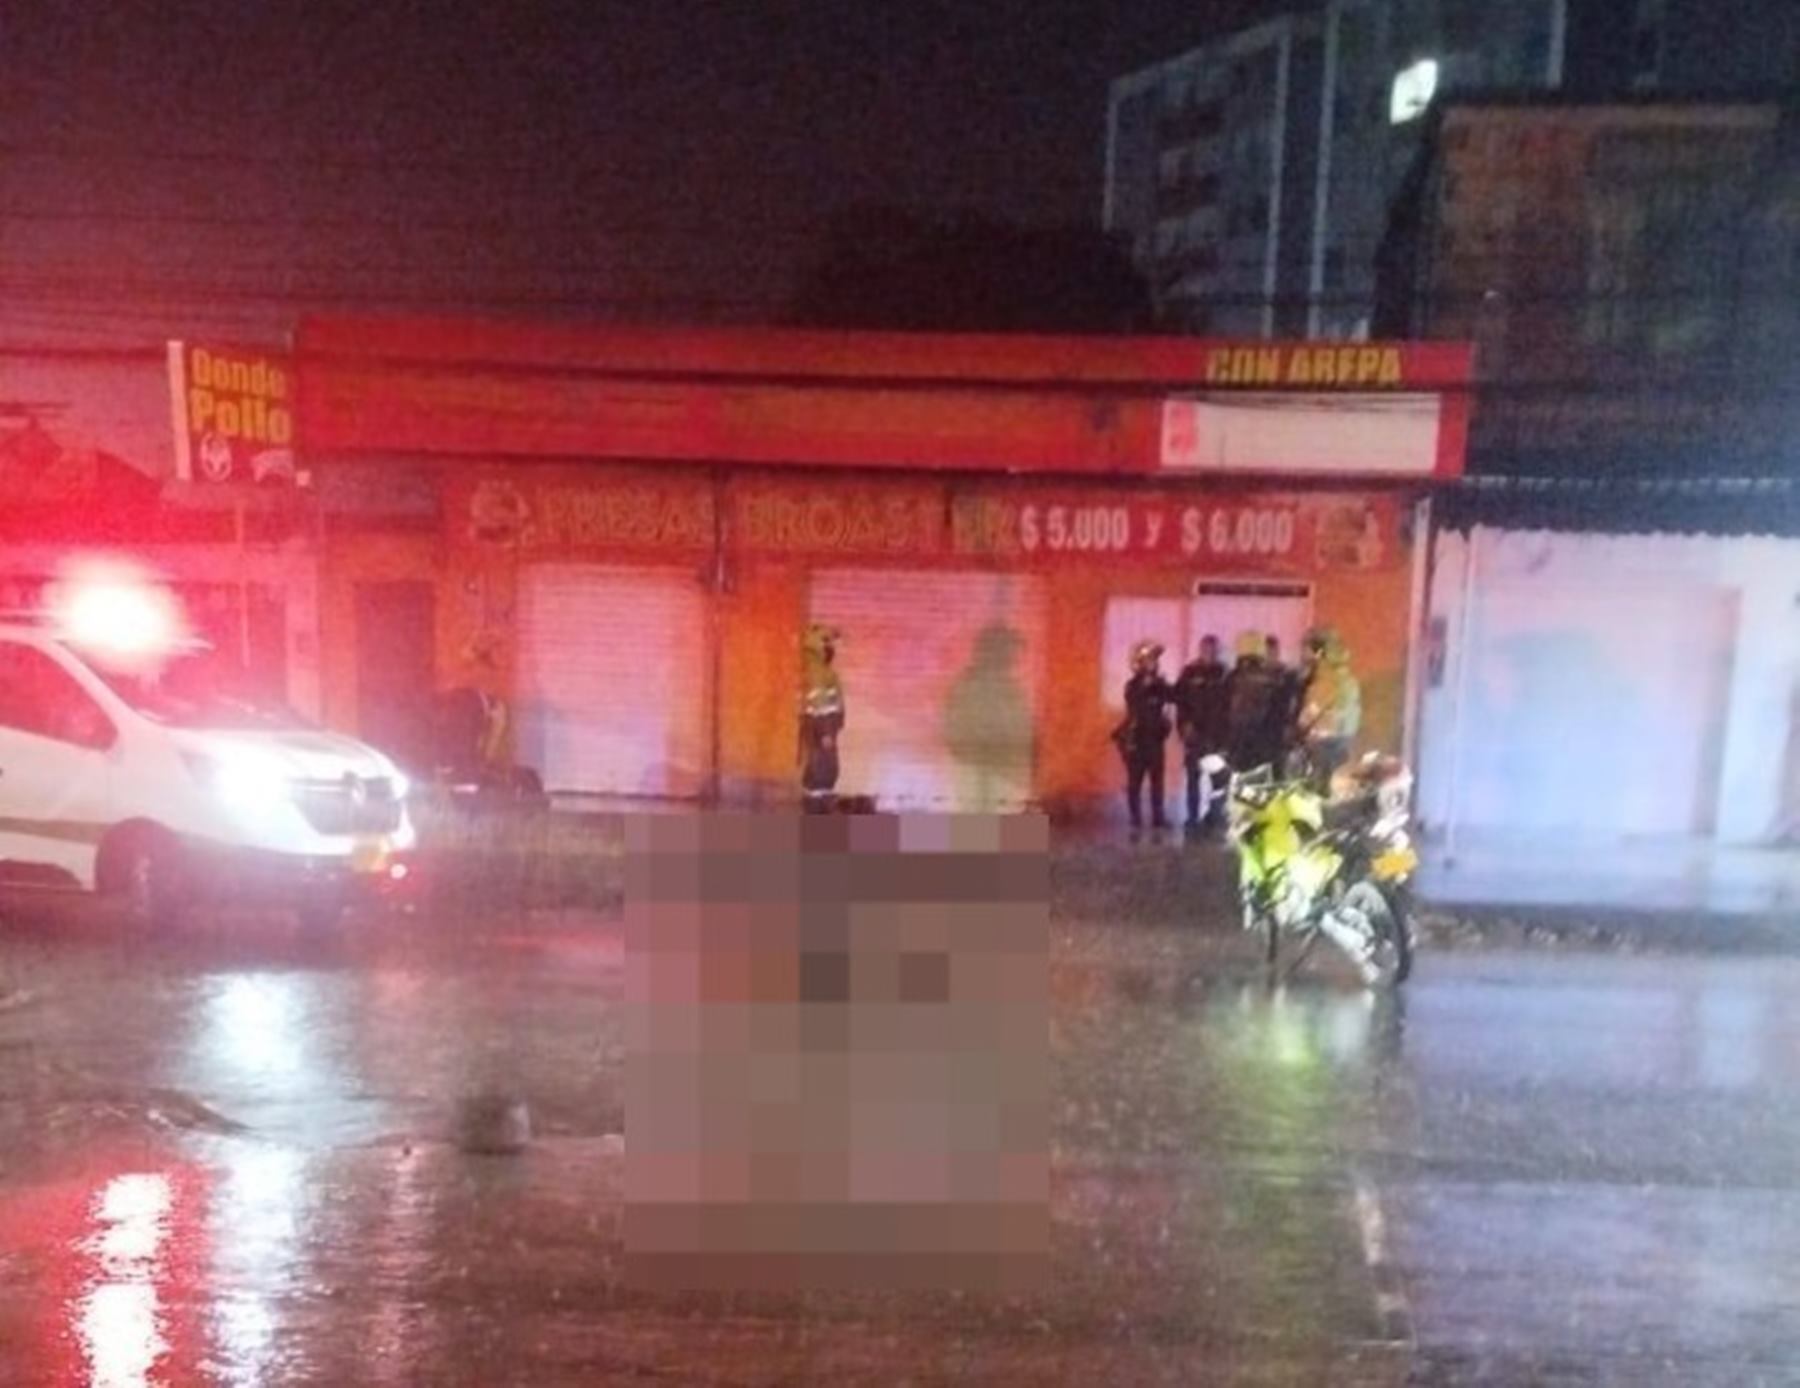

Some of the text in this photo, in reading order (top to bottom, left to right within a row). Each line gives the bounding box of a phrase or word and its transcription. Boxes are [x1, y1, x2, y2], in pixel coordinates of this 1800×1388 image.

[191, 347, 286, 398] Donde
[1205, 347, 1402, 383] CON AREPA
[190, 387, 292, 443] Pollo
[1020, 505, 1039, 549] $
[1047, 506, 1129, 550] 5.000
[1181, 507, 1200, 552] $
[1208, 508, 1293, 553] 6.000
